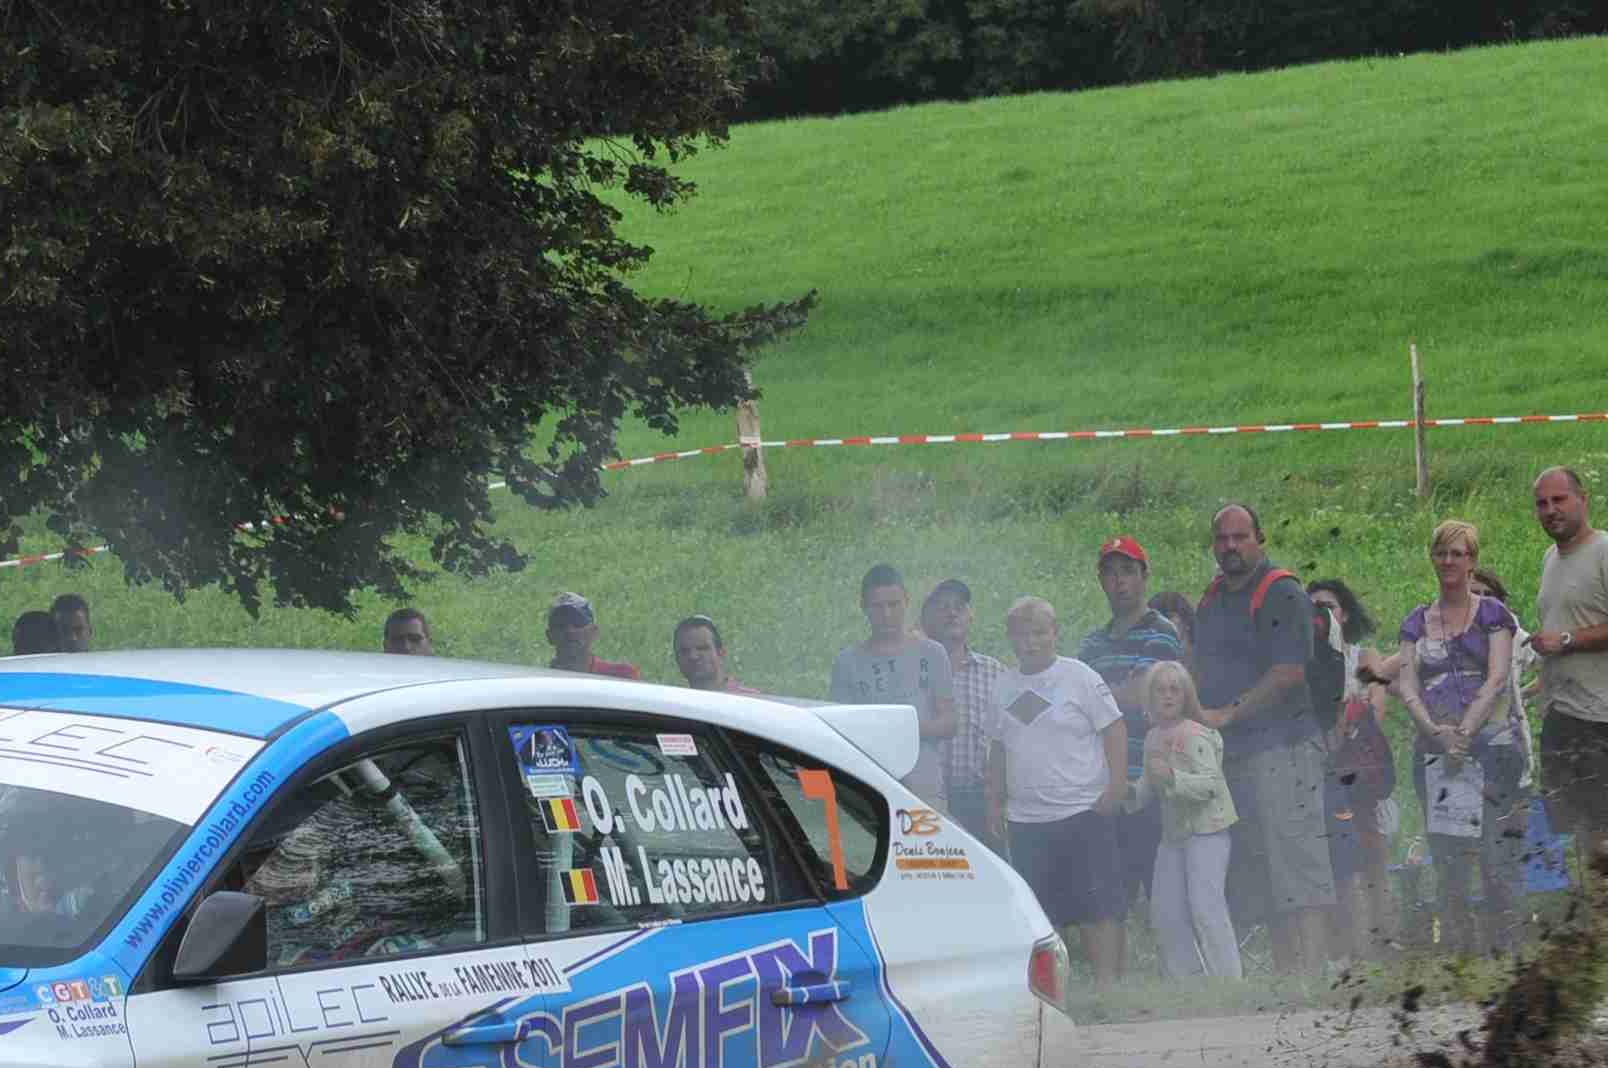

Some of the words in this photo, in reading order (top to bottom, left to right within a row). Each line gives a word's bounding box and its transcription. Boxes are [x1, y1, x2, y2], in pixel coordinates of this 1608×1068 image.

[581, 775, 626, 834] O.
[625, 772, 749, 832] Collard
[124, 769, 276, 949] www.oliviercollard.com
[599, 846, 641, 905] M.
[638, 845, 766, 904] Lassance
[378, 970, 439, 1004] RALLYE
[454, 960, 529, 995] FAMENNE
[522, 957, 562, 988] 2011
[48, 1008, 65, 1023] O.
[67, 997, 117, 1021] Collard
[56, 1025, 72, 1039] M.
[71, 1023, 127, 1038] Lassance
